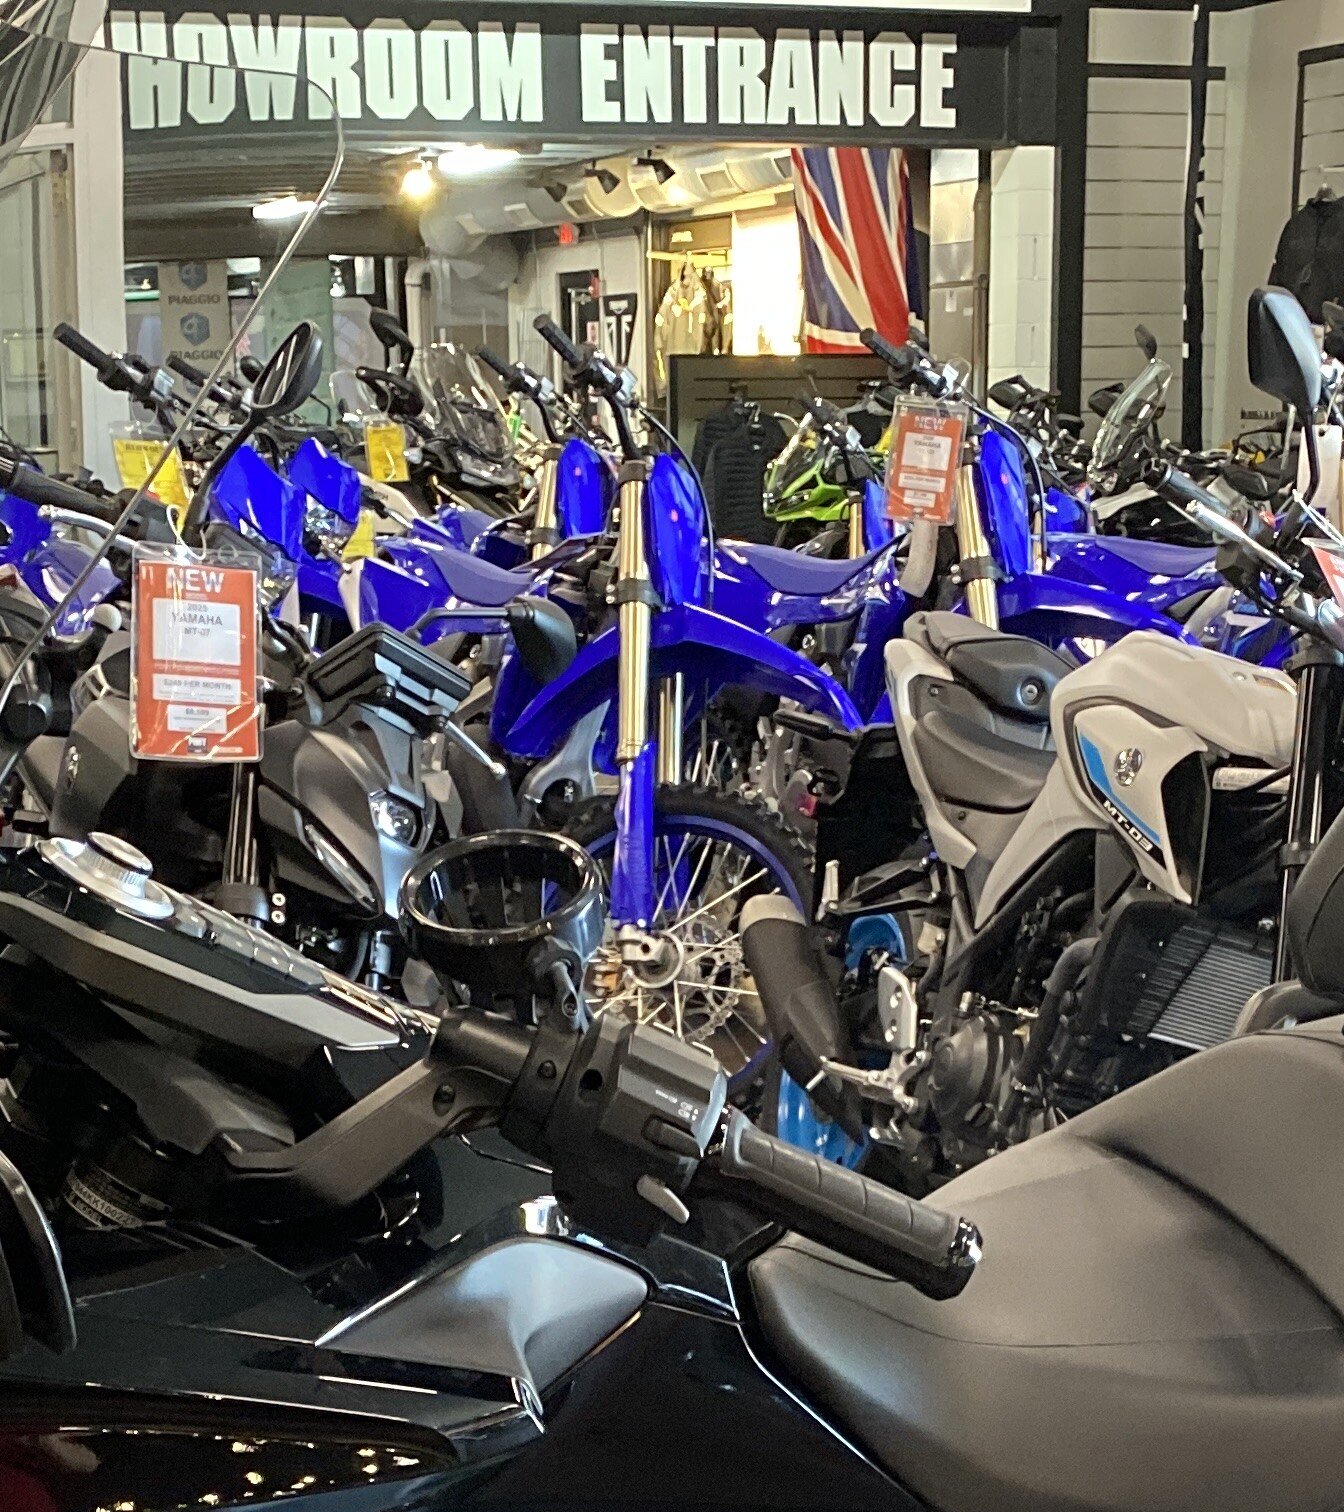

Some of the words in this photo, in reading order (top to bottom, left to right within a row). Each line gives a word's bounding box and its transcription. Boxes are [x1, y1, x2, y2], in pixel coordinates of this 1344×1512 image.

[580, 23, 957, 128] ENTRANCE
[167, 294, 221, 305] PIAGGIO
[166, 567, 225, 593] NEW
[172, 612, 224, 627] YAMAHA
[202, 680, 232, 690] MONTH
[1103, 800, 1154, 852] MT-03
